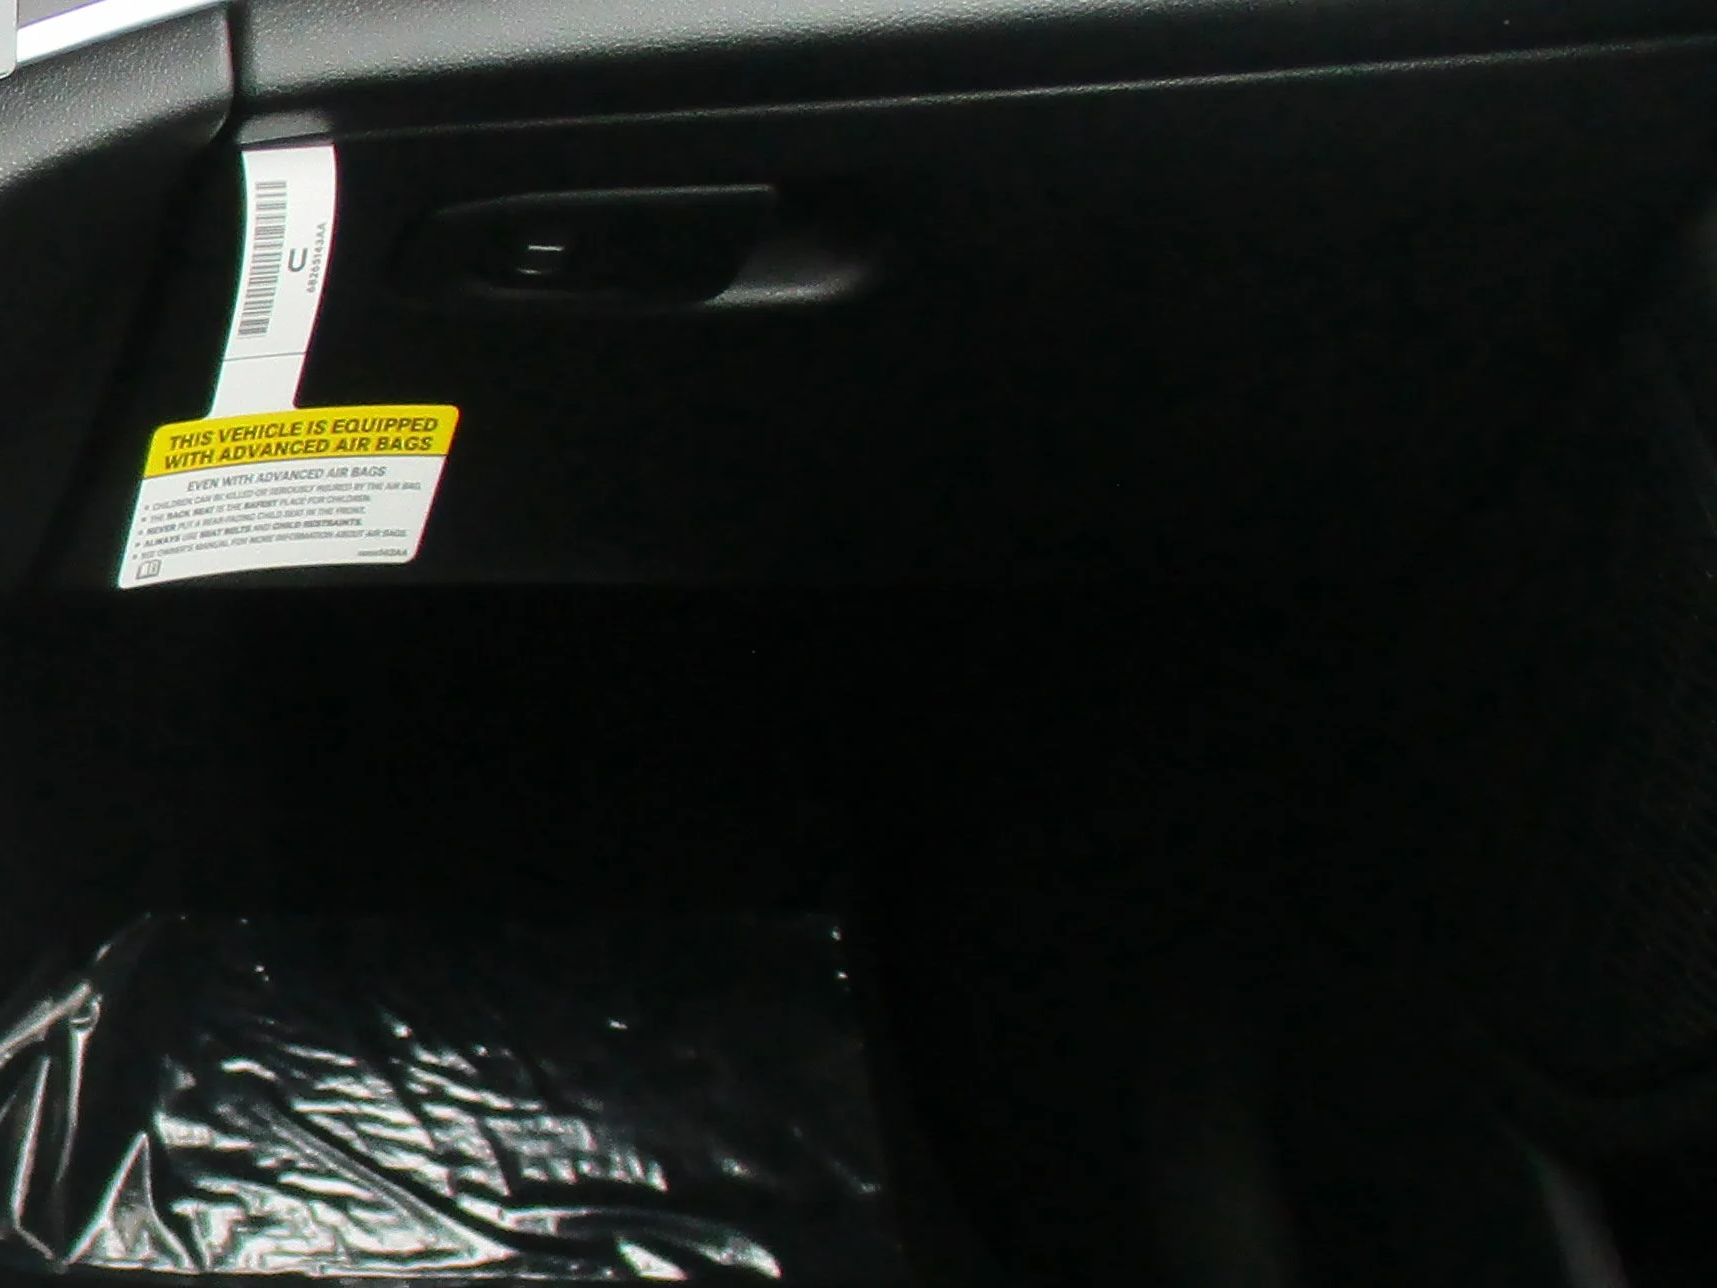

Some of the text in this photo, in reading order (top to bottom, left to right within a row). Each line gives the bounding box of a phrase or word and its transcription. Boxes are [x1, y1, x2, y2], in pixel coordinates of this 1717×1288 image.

[287, 247, 309, 273] U
[169, 417, 439, 451] THIS VEHICLE IS EQUIPPED
[164, 435, 434, 470] WITH ADVANCED AIR BAGS
[187, 466, 388, 492] EVEN WITH ADVANCED AIR BAGS
